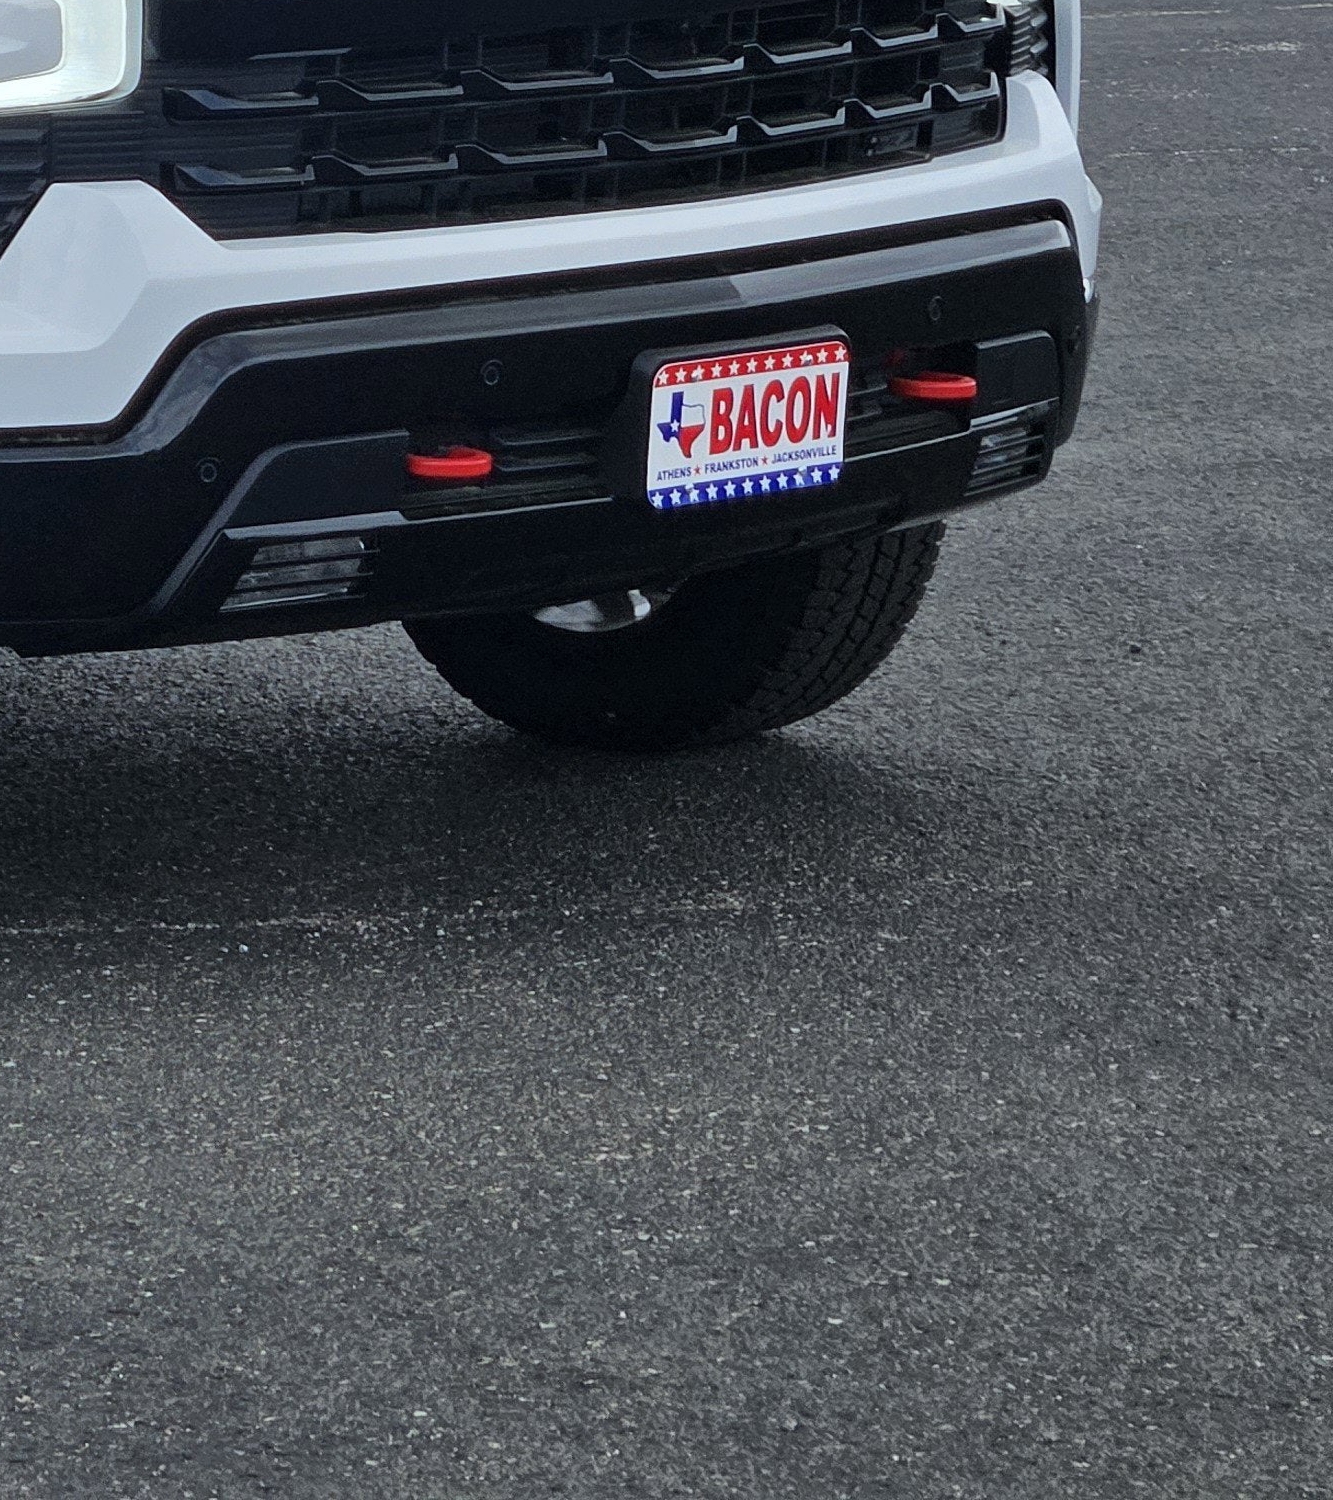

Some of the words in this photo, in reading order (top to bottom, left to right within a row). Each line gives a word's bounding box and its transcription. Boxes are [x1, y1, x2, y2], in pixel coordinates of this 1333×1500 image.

[709, 372, 840, 455] BACON
[656, 466, 692, 482] ATHENS
[704, 456, 759, 474] FRANKSTON
[771, 445, 837, 464] JACKSONVILLE
